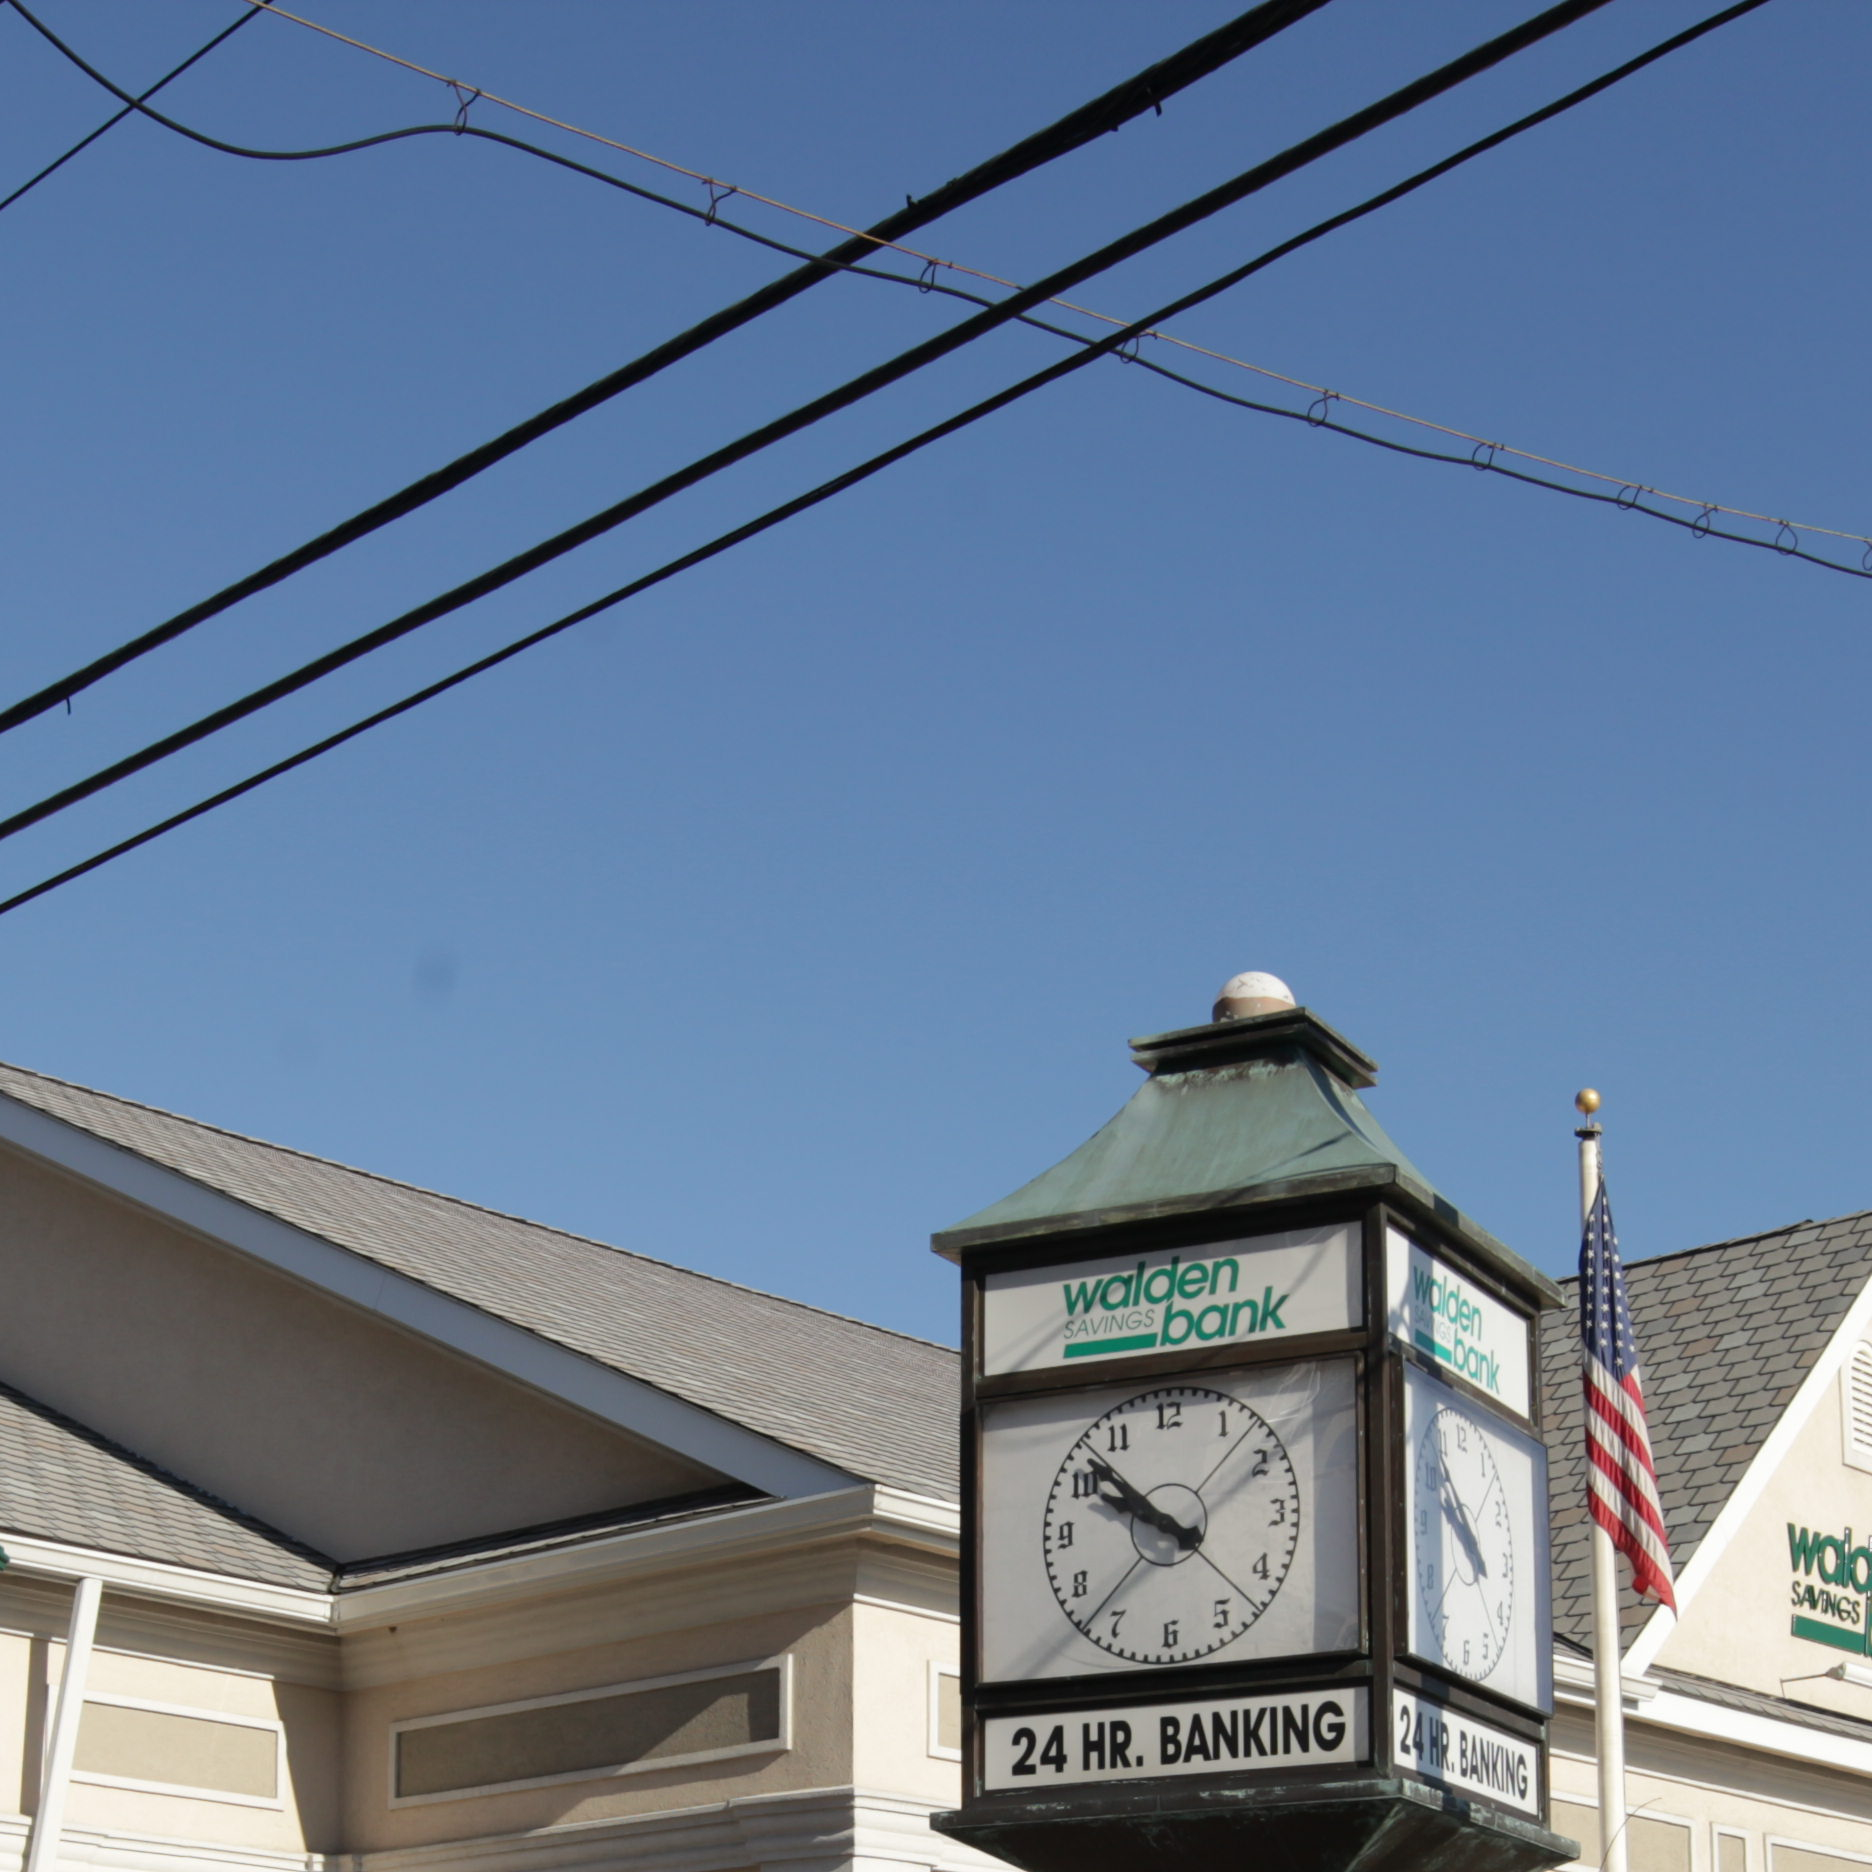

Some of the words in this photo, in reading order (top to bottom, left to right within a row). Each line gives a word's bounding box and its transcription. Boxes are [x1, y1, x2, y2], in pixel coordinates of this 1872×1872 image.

[1063, 1256, 1239, 1316] walden
[1063, 1309, 1155, 1339] SAVINGS
[1159, 1286, 1289, 1346] bank
[1414, 1266, 1482, 1341] walden
[1454, 1327, 1500, 1395] bank
[1156, 1401, 1182, 1429] 12
[1218, 1410, 1229, 1437] 1
[1107, 1423, 1130, 1451] 11
[1252, 1449, 1269, 1477] 2
[1071, 1470, 1100, 1499] 10
[1268, 1498, 1285, 1527] 3
[1057, 1521, 1074, 1549] 9
[1252, 1553, 1270, 1580] 4
[1071, 1570, 1088, 1598] 8
[1213, 1599, 1230, 1628] 5
[1791, 1581, 1860, 1624] SAVINGS
[1110, 1609, 1126, 1639] 7
[1161, 1620, 1179, 1648] 6
[1011, 1725, 1067, 1776] 24
[1082, 1720, 1144, 1771] HR.
[1160, 1700, 1346, 1765] BANKING
[1400, 1705, 1424, 1760] 24
[1429, 1717, 1454, 1773] HR.
[1460, 1729, 1528, 1800] BANKING
